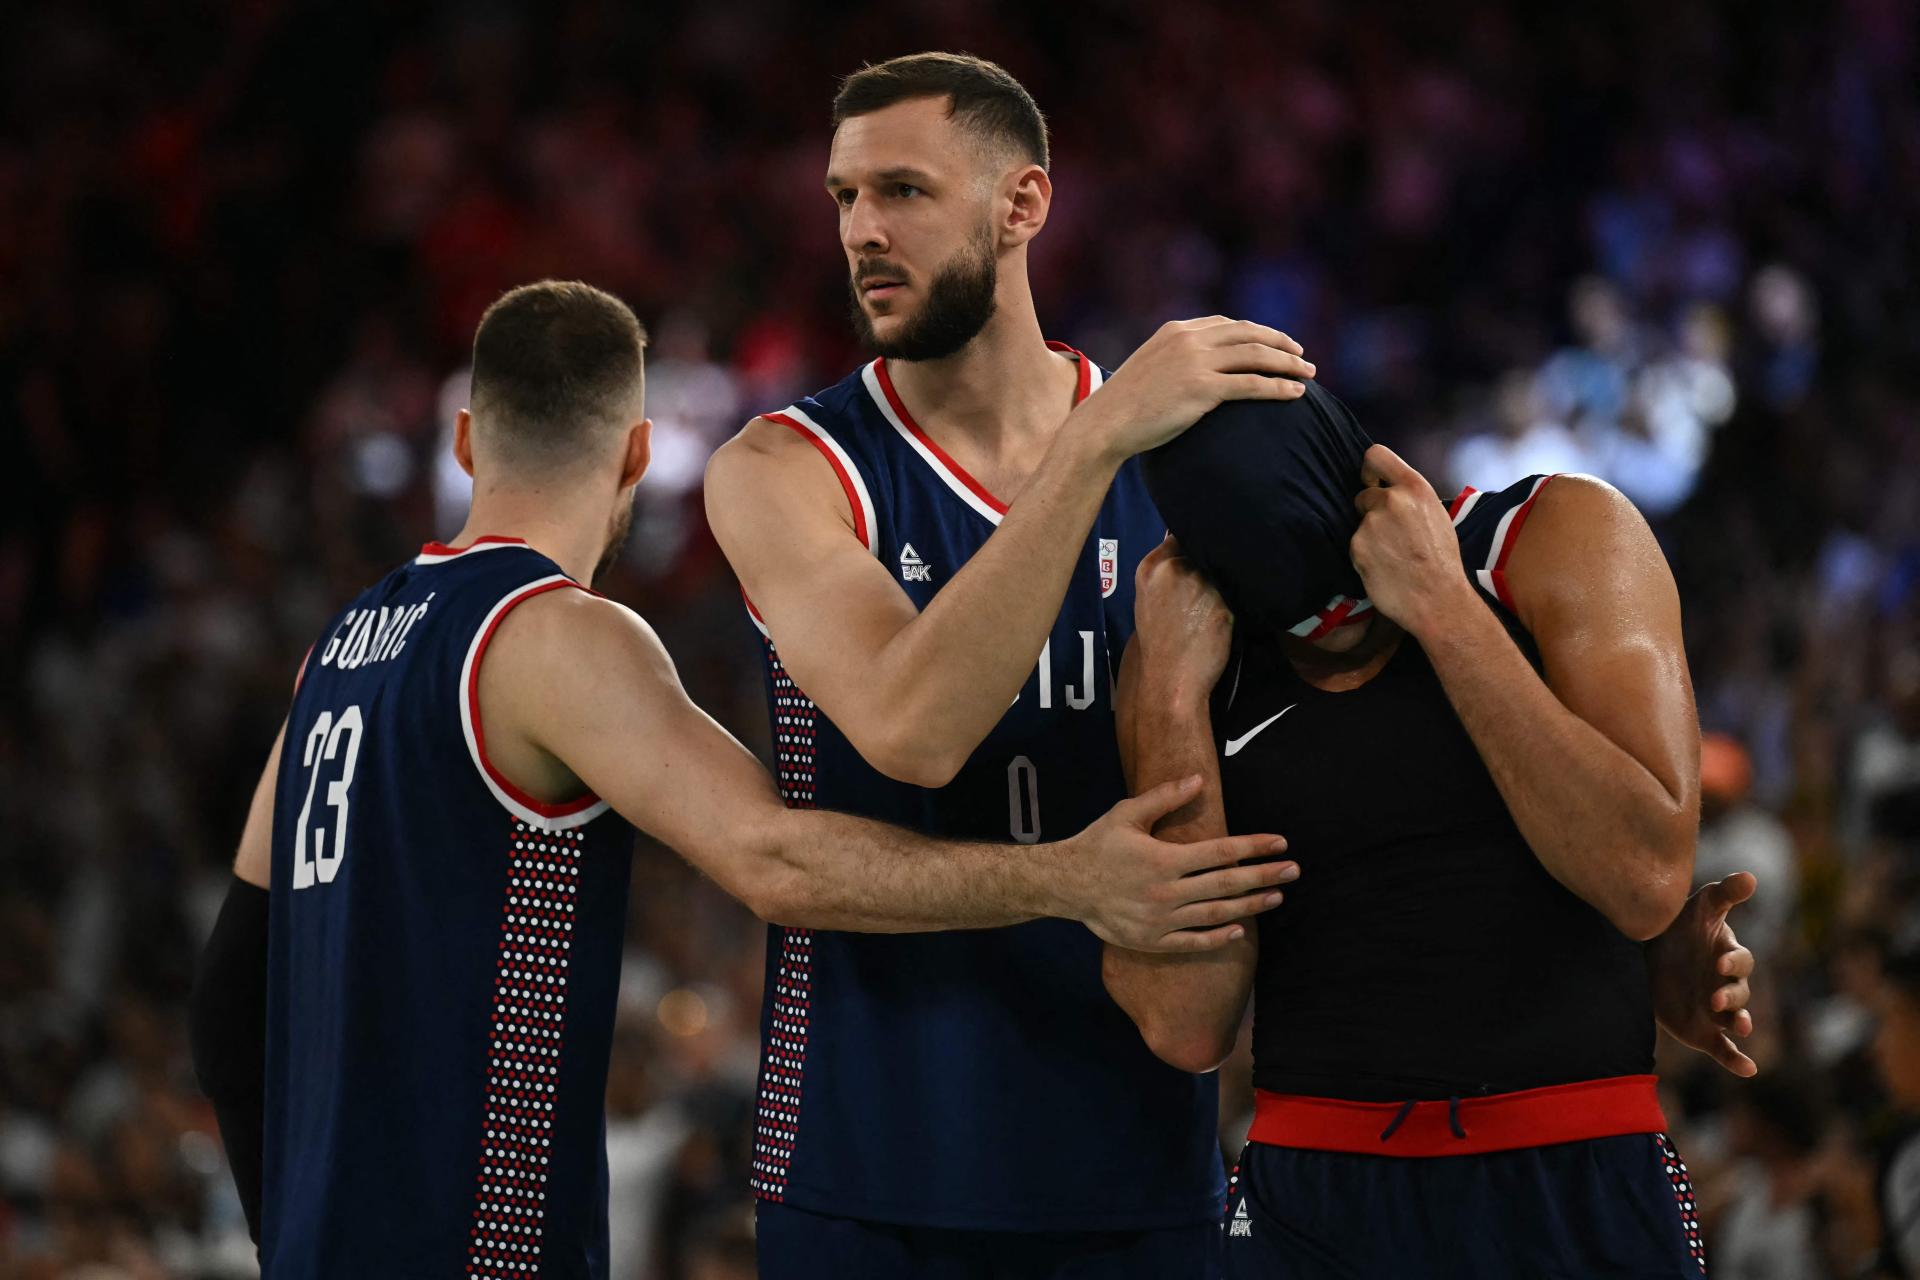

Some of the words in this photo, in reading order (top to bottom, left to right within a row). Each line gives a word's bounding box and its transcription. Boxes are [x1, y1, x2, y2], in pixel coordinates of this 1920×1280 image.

[901, 565, 932, 581] EAK
[293, 705, 364, 890] 23
[1007, 755, 1042, 844] 0
